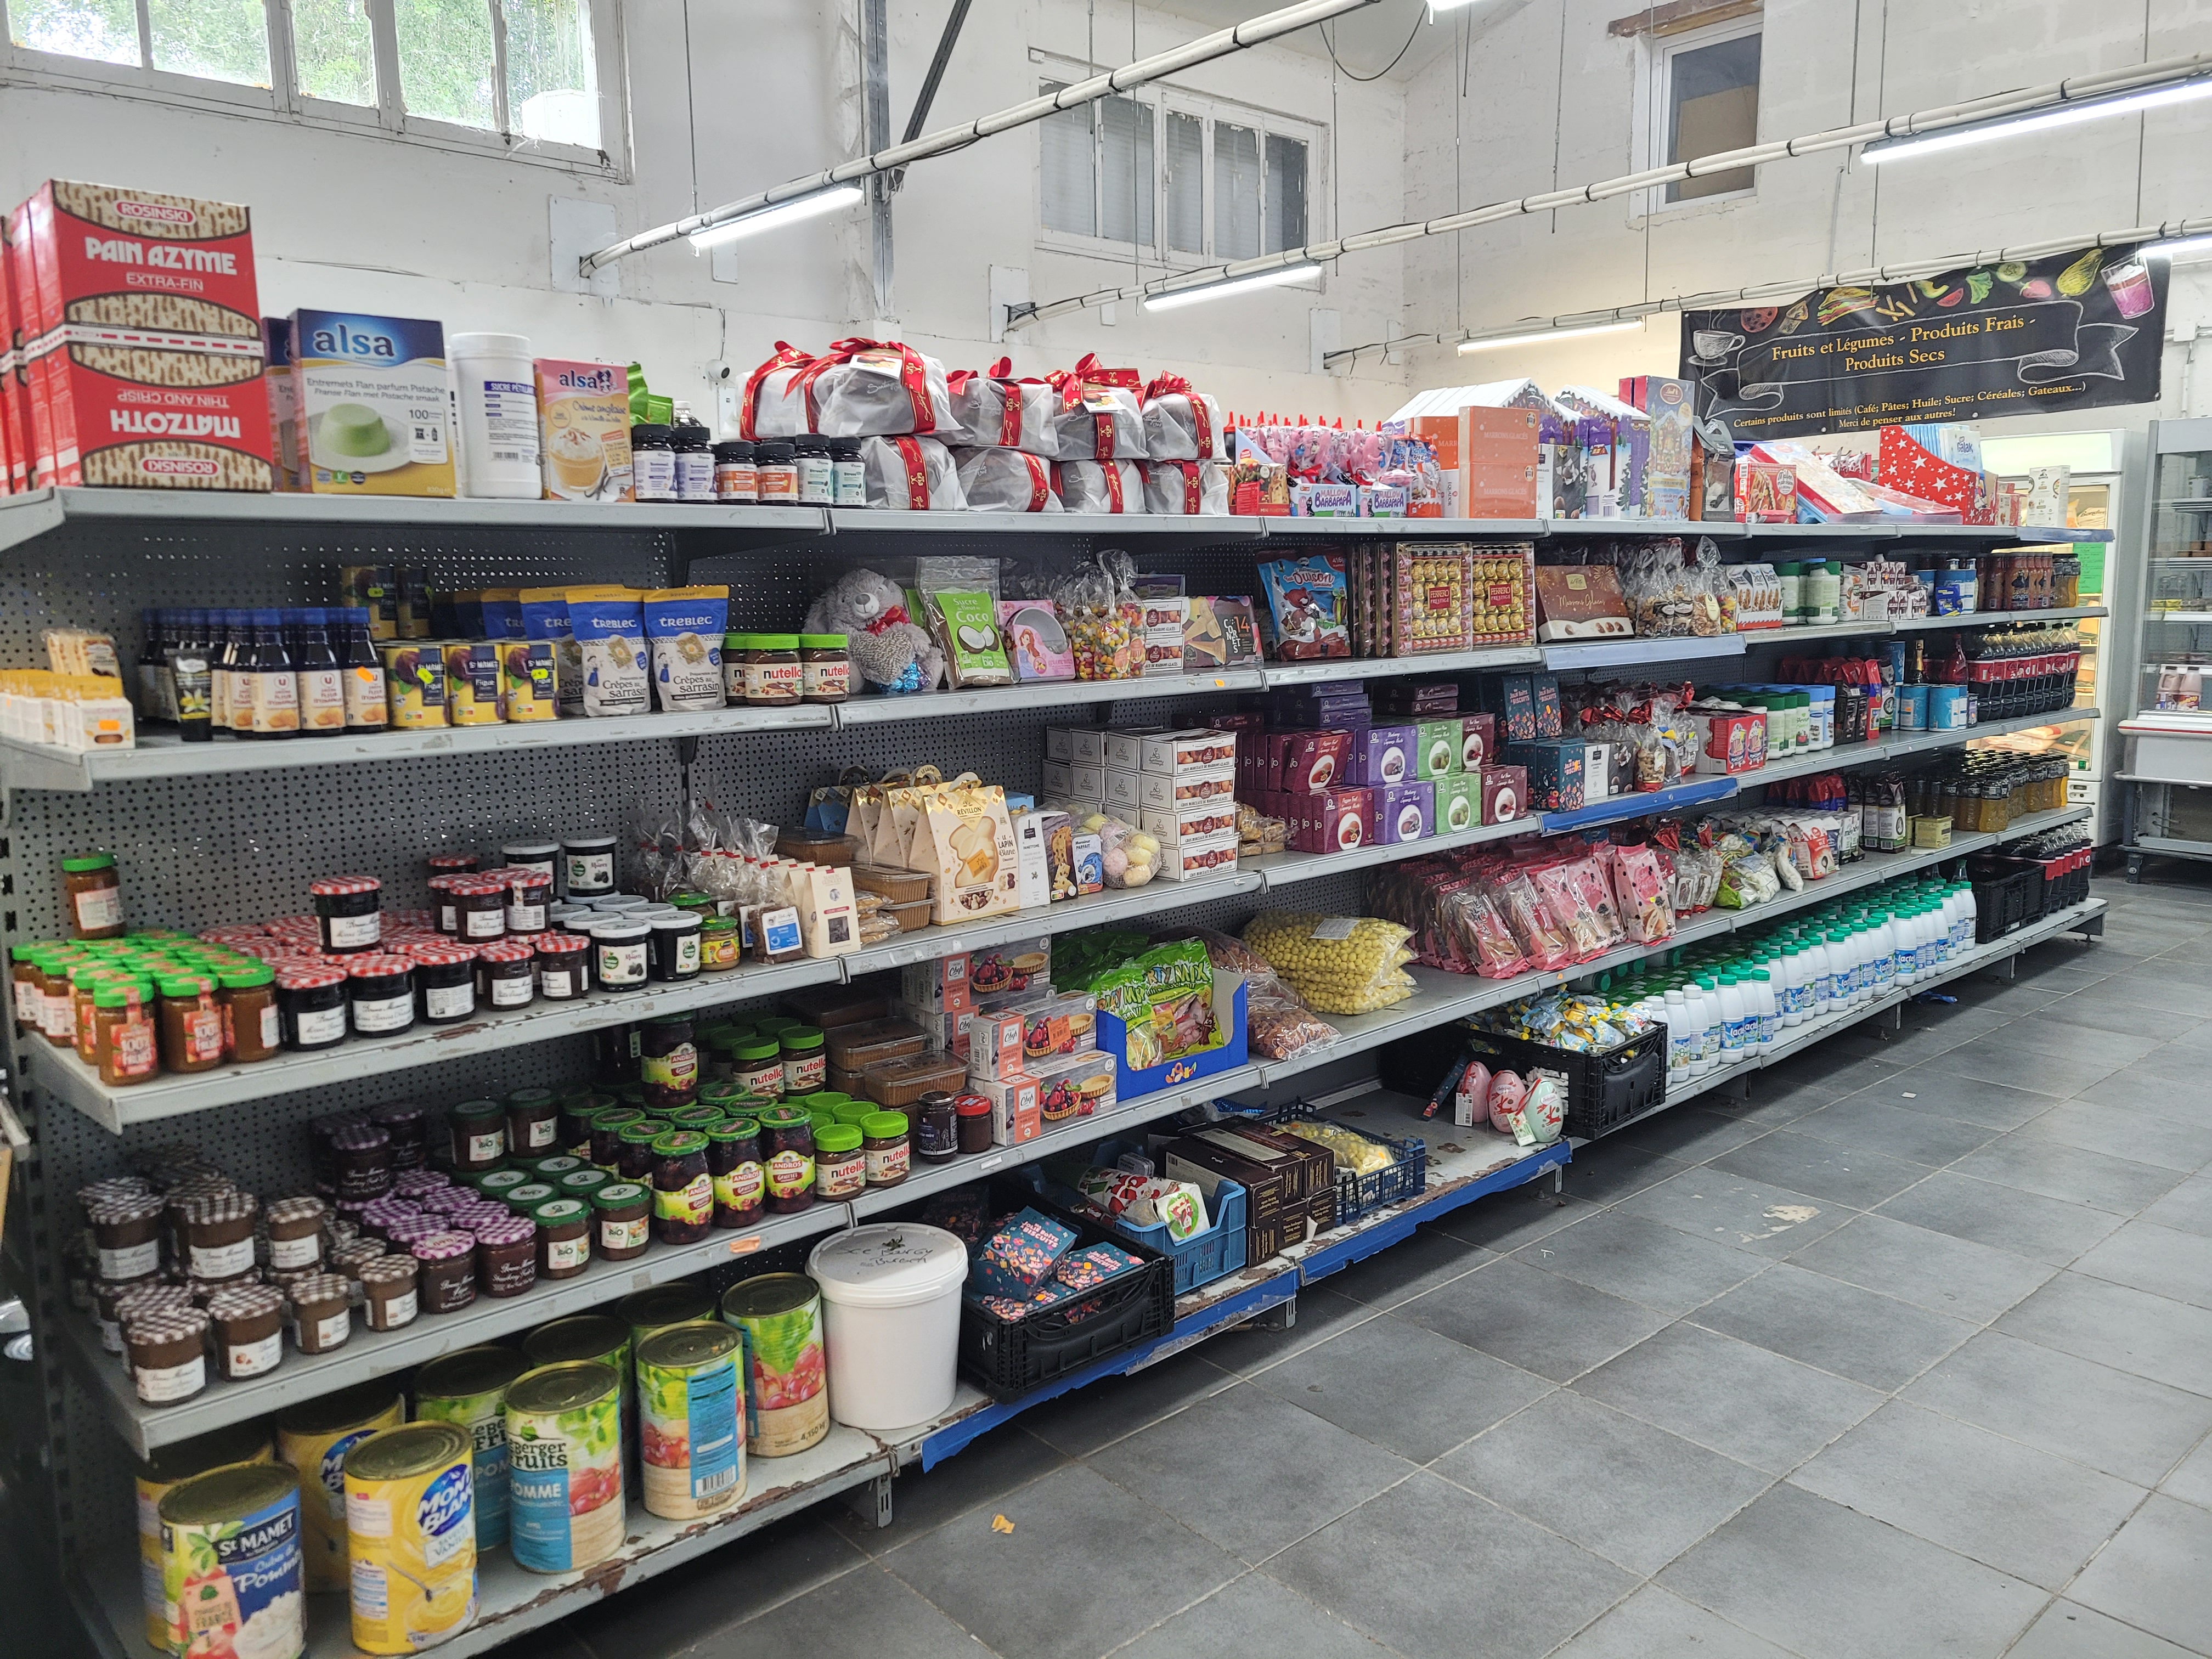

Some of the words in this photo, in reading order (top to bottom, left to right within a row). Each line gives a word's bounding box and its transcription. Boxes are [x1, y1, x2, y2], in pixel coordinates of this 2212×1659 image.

[121, 202, 189, 222] ROSINSKI
[85, 236, 144, 264] PAIN
[148, 246, 238, 275] AZYME
[126, 272, 204, 291] EXTRA-FIN
[314, 324, 395, 357] alsa
[1771, 343, 1815, 362] Fruits
[1820, 342, 1833, 354] et
[1836, 335, 1894, 354] Légumes
[1910, 321, 1979, 343] Produits
[1985, 314, 2024, 333] Frais
[1844, 352, 1904, 372] Produits
[1909, 348, 1945, 365] Secs
[558, 370, 598, 389] alsa
[117, 388, 162, 404] CRISP
[163, 392, 197, 407] AND
[199, 395, 230, 409] THIN
[1734, 417, 1765, 428] Certains
[1768, 413, 1805, 427] produits
[1806, 411, 1827, 419] sont
[1828, 407, 1852, 417] limités
[1854, 404, 1879, 416] (Café;
[1881, 401, 1910, 413] Pâtes;
[1912, 397, 1942, 409] Huile;
[1944, 393, 1975, 405] Sucre;
[1977, 388, 2025, 402] Céréales;
[110, 409, 241, 438] MATZOTH
[1838, 419, 1859, 428] Merci
[1861, 419, 1871, 427] de
[1873, 416, 1903, 427] penser
[1905, 413, 1922, 421] aux
[1924, 408, 1956, 420] autres!
[148, 460, 213, 474] ROSINSKI
[1430, 590, 1450, 599] FERRERO
[1491, 586, 1511, 595] FERRERO
[956, 611, 989, 623] Coco
[603, 679, 634, 690] Crêpes
[673, 675, 704, 685] Crêpes
[679, 682, 719, 693] sarrasin
[956, 806, 983, 816] RÉVILLON
[998, 840, 1014, 849] LAPIN
[1175, 964, 1206, 983] MIX
[672, 1053, 696, 1063] ANDROS
[774, 1160, 802, 1170] ANDROS
[733, 1170, 760, 1182] ANDROS
[1023, 1227, 1058, 1249] BISCUITS
[420, 1488, 473, 1536] BLAN
[241, 1511, 295, 1552] MAMET
